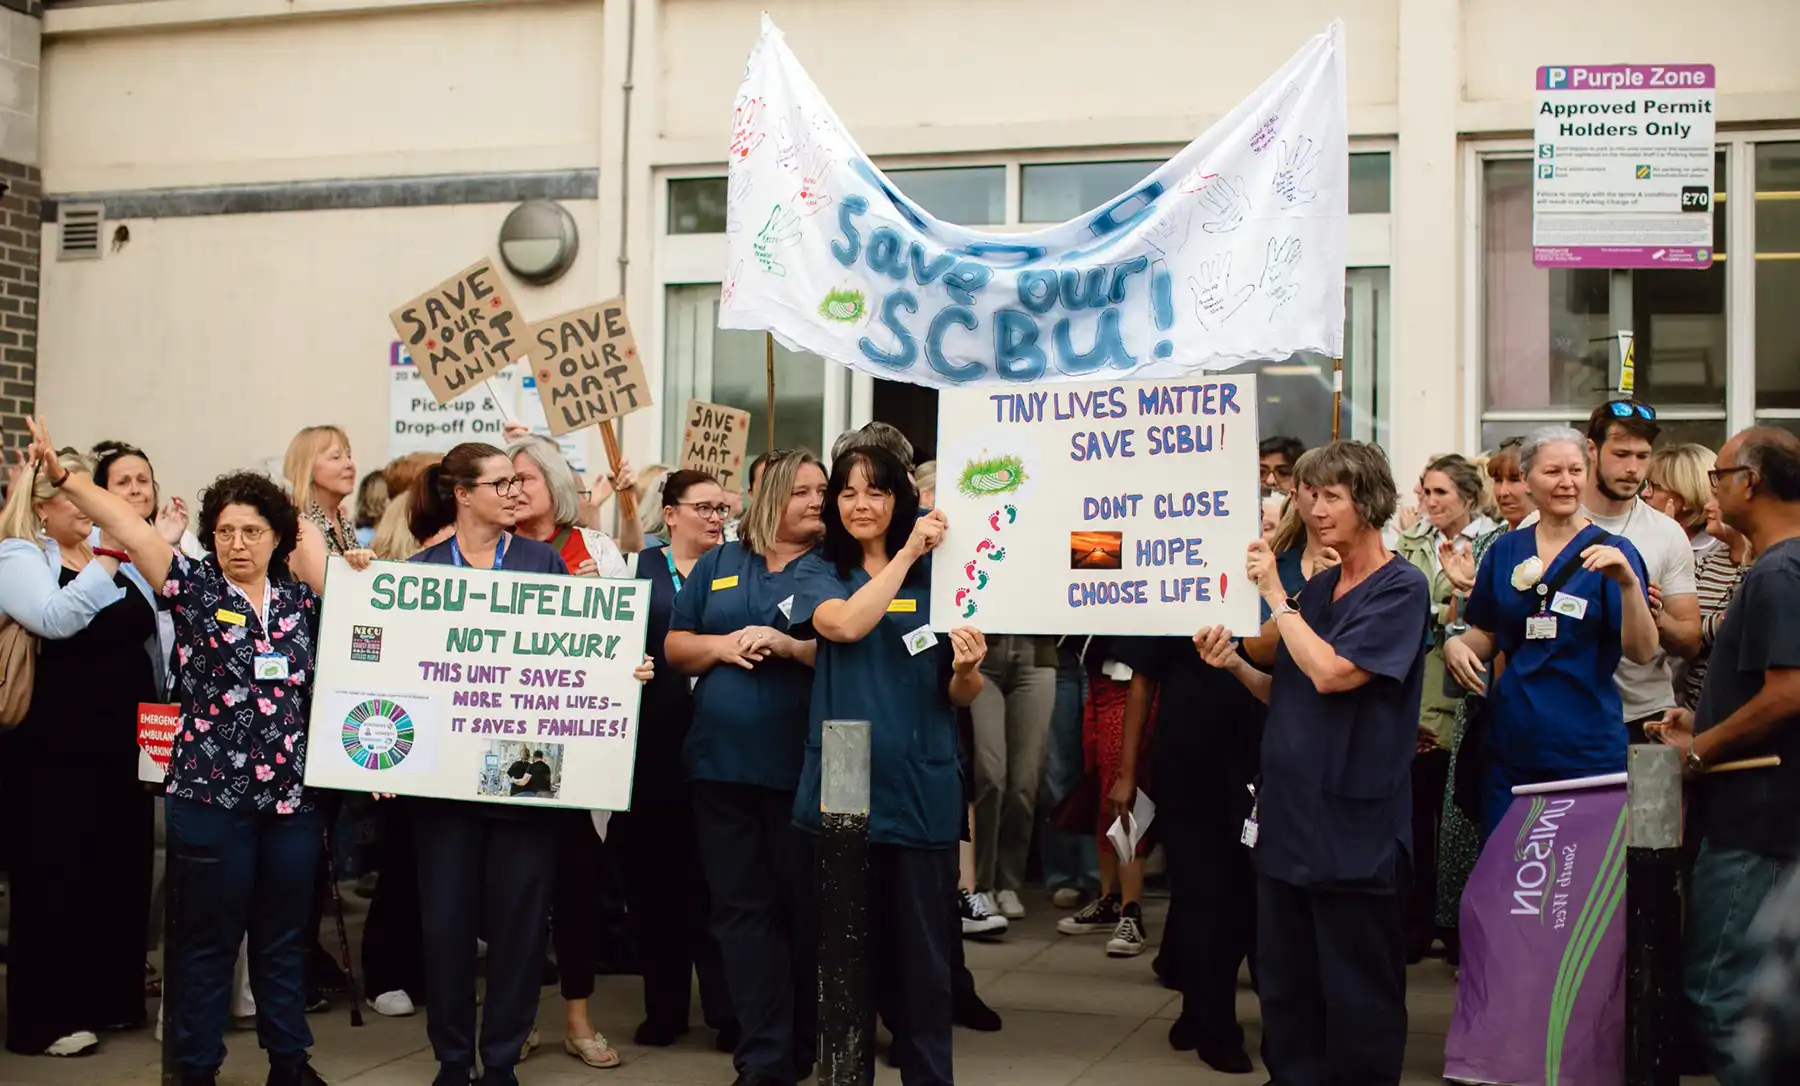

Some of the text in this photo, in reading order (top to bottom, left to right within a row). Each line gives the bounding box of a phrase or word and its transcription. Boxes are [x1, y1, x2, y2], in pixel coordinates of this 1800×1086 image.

[1573, 68, 1644, 90] Purple
[1650, 68, 1706, 86] Zone
[1540, 98, 1713, 118] Approved Permit
[1559, 121, 1692, 139] Holders Only
[1682, 192, 1708, 206] £70
[831, 194, 1148, 314] Save our
[401, 266, 494, 345] SAVE
[440, 307, 486, 343] OUR
[537, 307, 626, 360] SAVE
[429, 310, 513, 376] MAT
[559, 342, 623, 377] OUR
[395, 372, 408, 381] 20
[552, 365, 628, 406] MAT
[411, 397, 495, 414] Pick-up &
[990, 383, 1240, 422] TINY LIVES MATTER
[395, 419, 502, 435] Drop-off Onl
[691, 405, 735, 433] SAVE
[688, 441, 731, 464] MAT
[703, 431, 728, 448] OUR
[1070, 429, 1136, 461] SAVE
[1154, 490, 1229, 519] CLOSE
[1136, 538, 1208, 568] HOPE,
[1068, 580, 1148, 608] CHOOSE
[354, 626, 381, 636] NICU
[446, 627, 506, 653] NOT
[418, 661, 587, 688] THIS UNIT SAVES
[453, 691, 502, 708] MORE
[511, 693, 559, 711] THAN
[140, 713, 179, 726] EMERGENC
[452, 717, 628, 739] IT SAVES FAMILIES!
